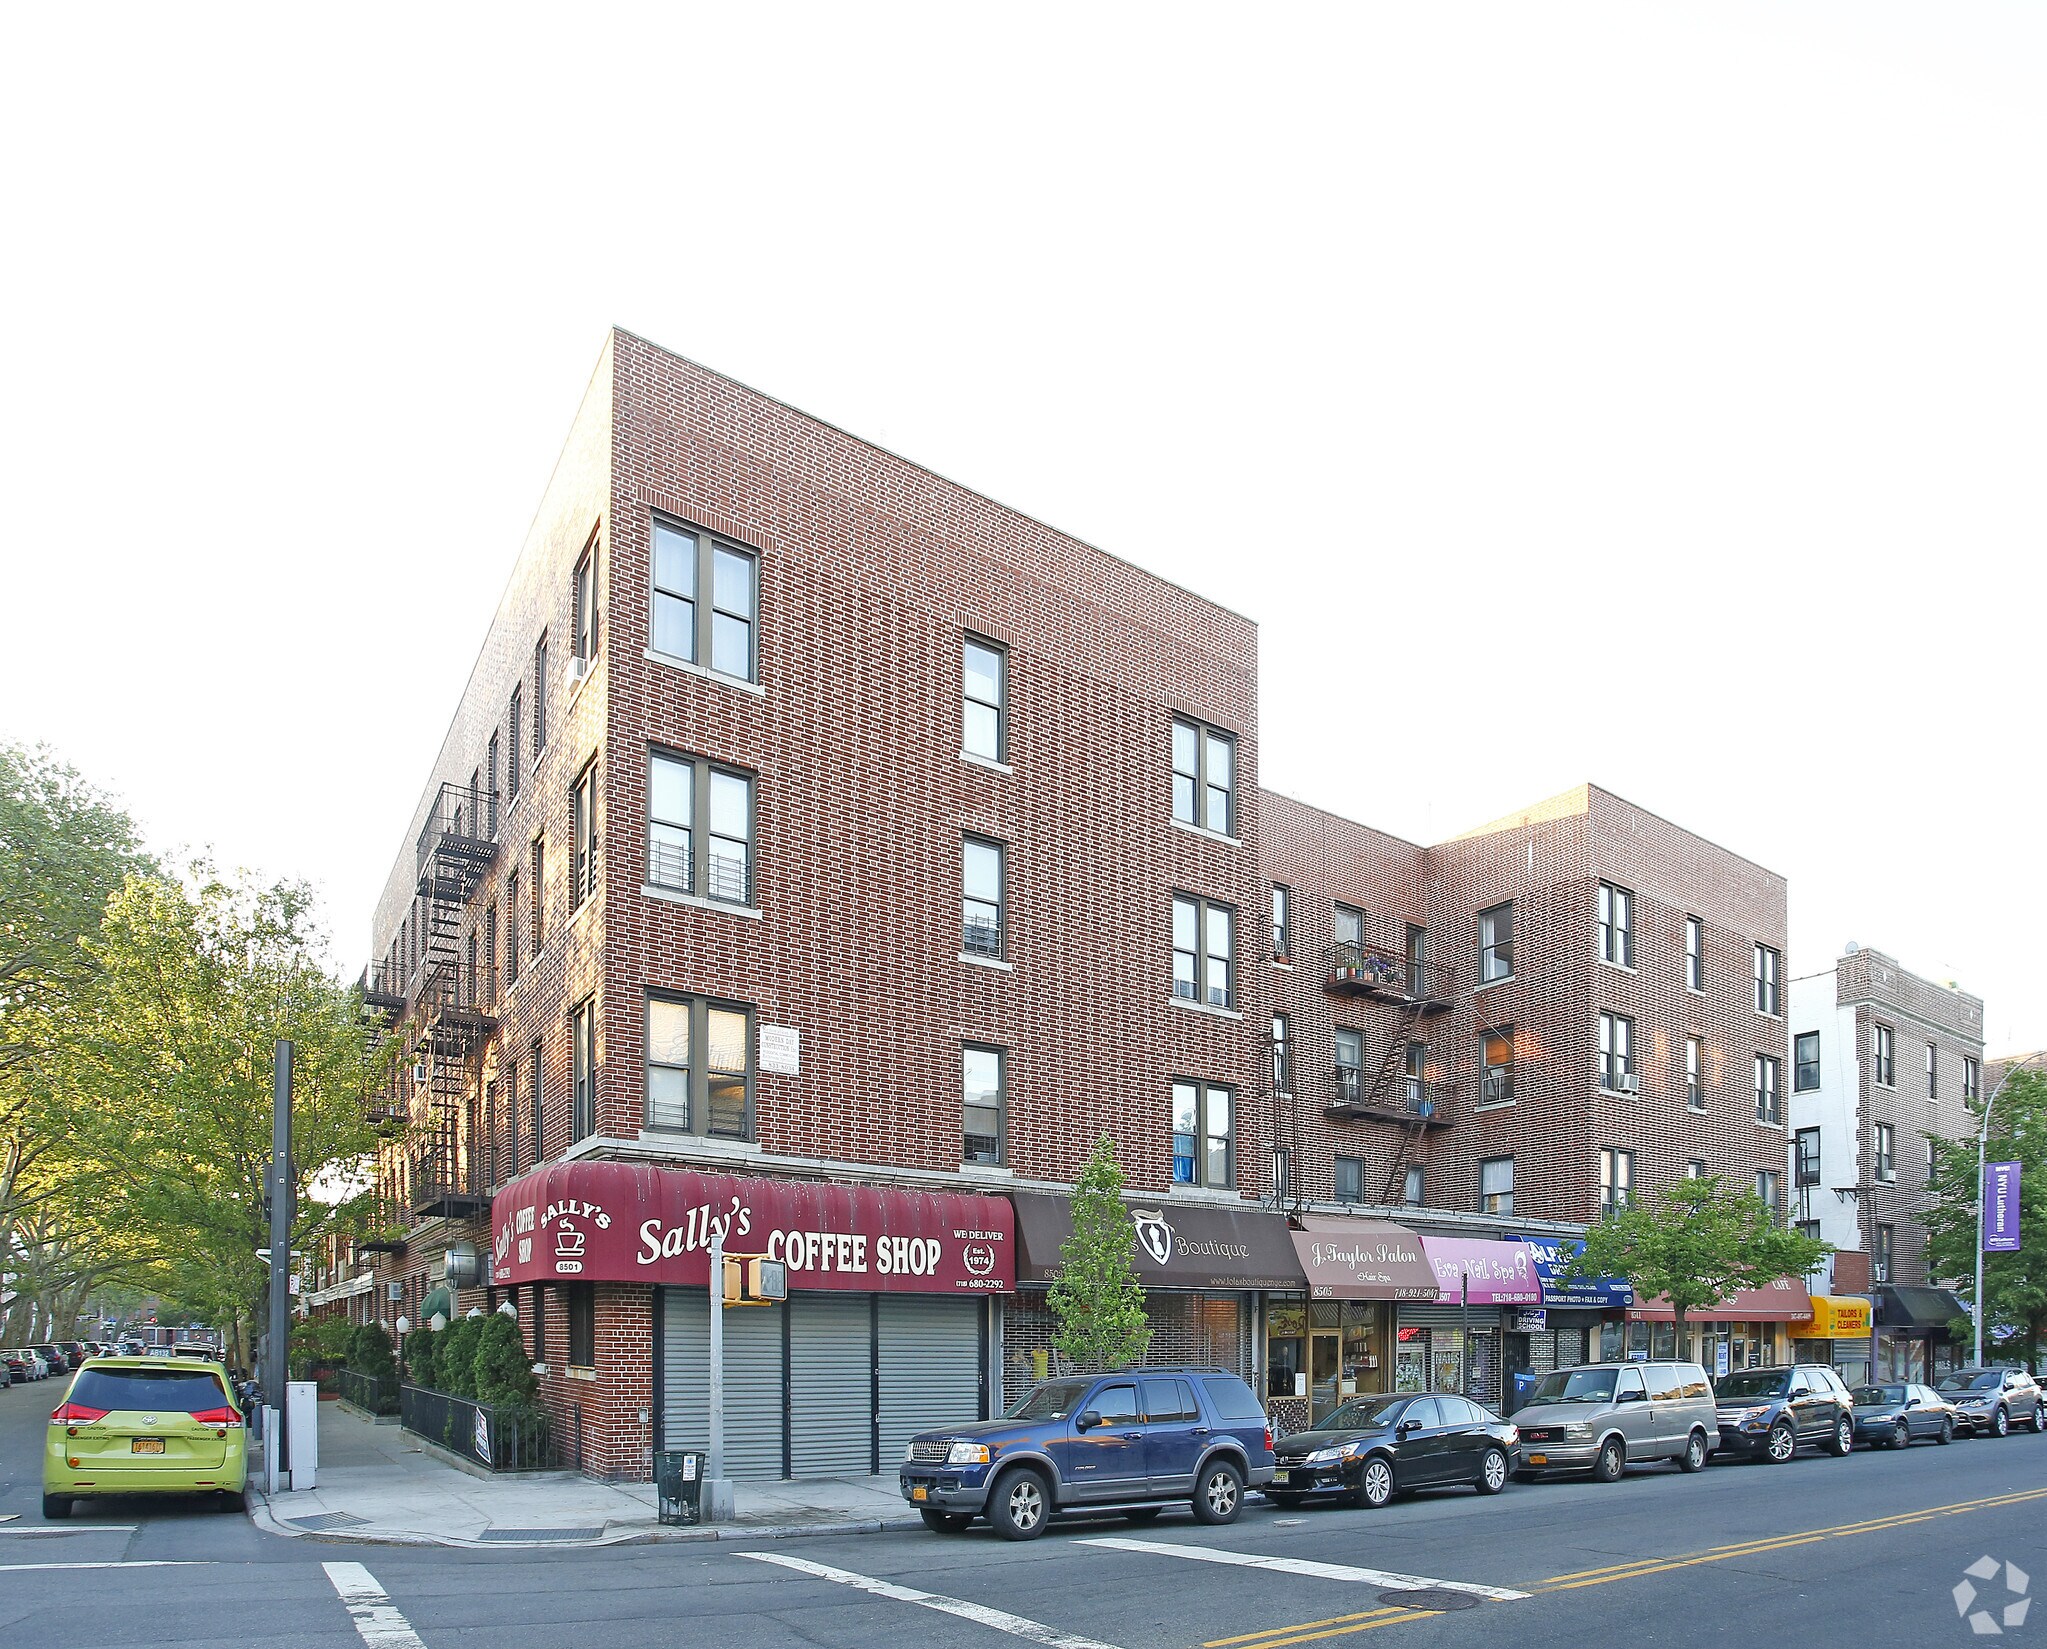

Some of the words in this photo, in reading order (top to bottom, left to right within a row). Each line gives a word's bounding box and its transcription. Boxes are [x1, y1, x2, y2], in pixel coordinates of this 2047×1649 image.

[1997, 1174, 2008, 1194] NYU
[516, 1205, 536, 1235] COFFEE
[540, 1199, 612, 1230] SALLY'S
[1996, 1194, 2007, 1233] Lutheran
[636, 1195, 751, 1265] Sally's
[768, 1229, 867, 1272] COFFEE
[876, 1235, 942, 1276] SHOP
[953, 1229, 967, 1239] WE
[968, 1230, 1004, 1241] DELIVER
[518, 1237, 532, 1264] SHOP
[1174, 1236, 1250, 1260] Boutique
[1376, 1243, 1417, 1263] Salon
[968, 1256, 990, 1265] 1974
[1433, 1257, 1459, 1278] Eva
[1462, 1257, 1490, 1280] Nail
[1491, 1259, 1515, 1285] Spa
[969, 1279, 1004, 1289] 680-2292
[1313, 1286, 1333, 1297] 8505
[1545, 1294, 1566, 1302] PASSPORT
[1567, 1295, 1581, 1303] PHOTO
[1597, 1296, 1609, 1304] COPY
[1518, 1316, 1544, 1325] DRIVING
[1837, 1309, 1857, 1318] TAILORS
[1517, 1322, 1544, 1330] SCHOOL
[1837, 1320, 1861, 1329] CLEANERS
